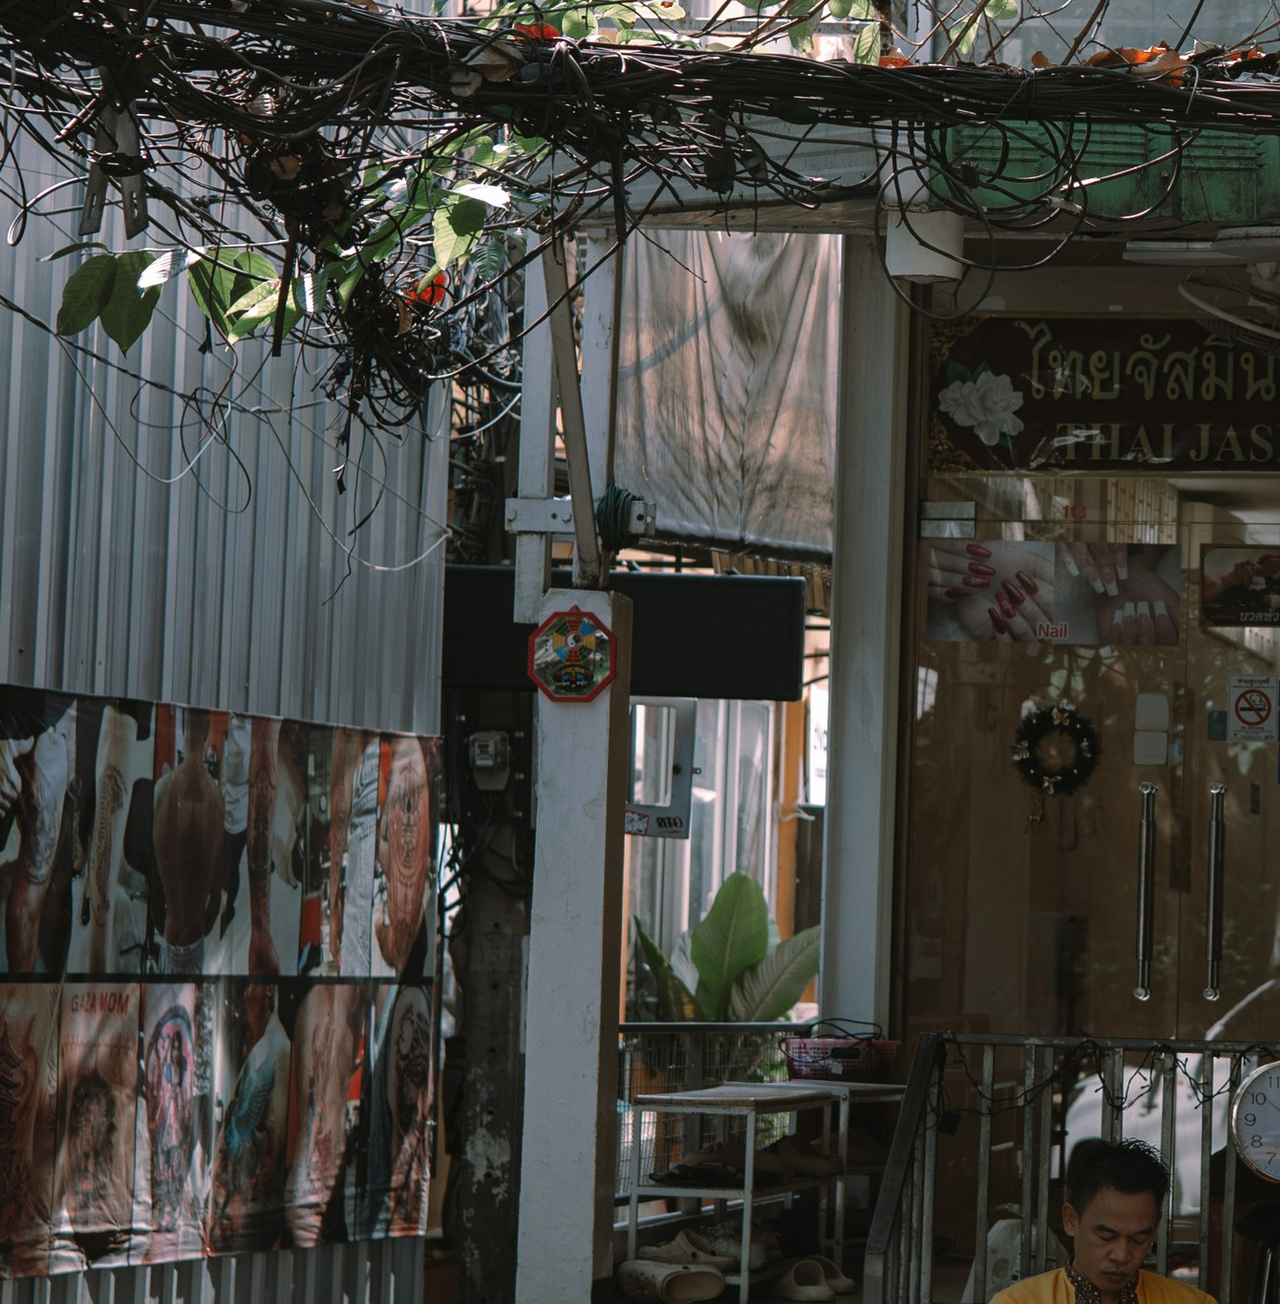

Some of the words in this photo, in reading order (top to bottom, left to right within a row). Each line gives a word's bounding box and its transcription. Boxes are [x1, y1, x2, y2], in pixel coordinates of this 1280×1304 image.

[1055, 422, 1177, 462] THAI
[1038, 621, 1068, 638] Nail
[1268, 1076, 1280, 1089] 11
[1251, 1092, 1267, 1106] 10
[1244, 1113, 1256, 1127] 9
[1251, 1135, 1263, 1148] 8
[1266, 1152, 1277, 1165] 7
